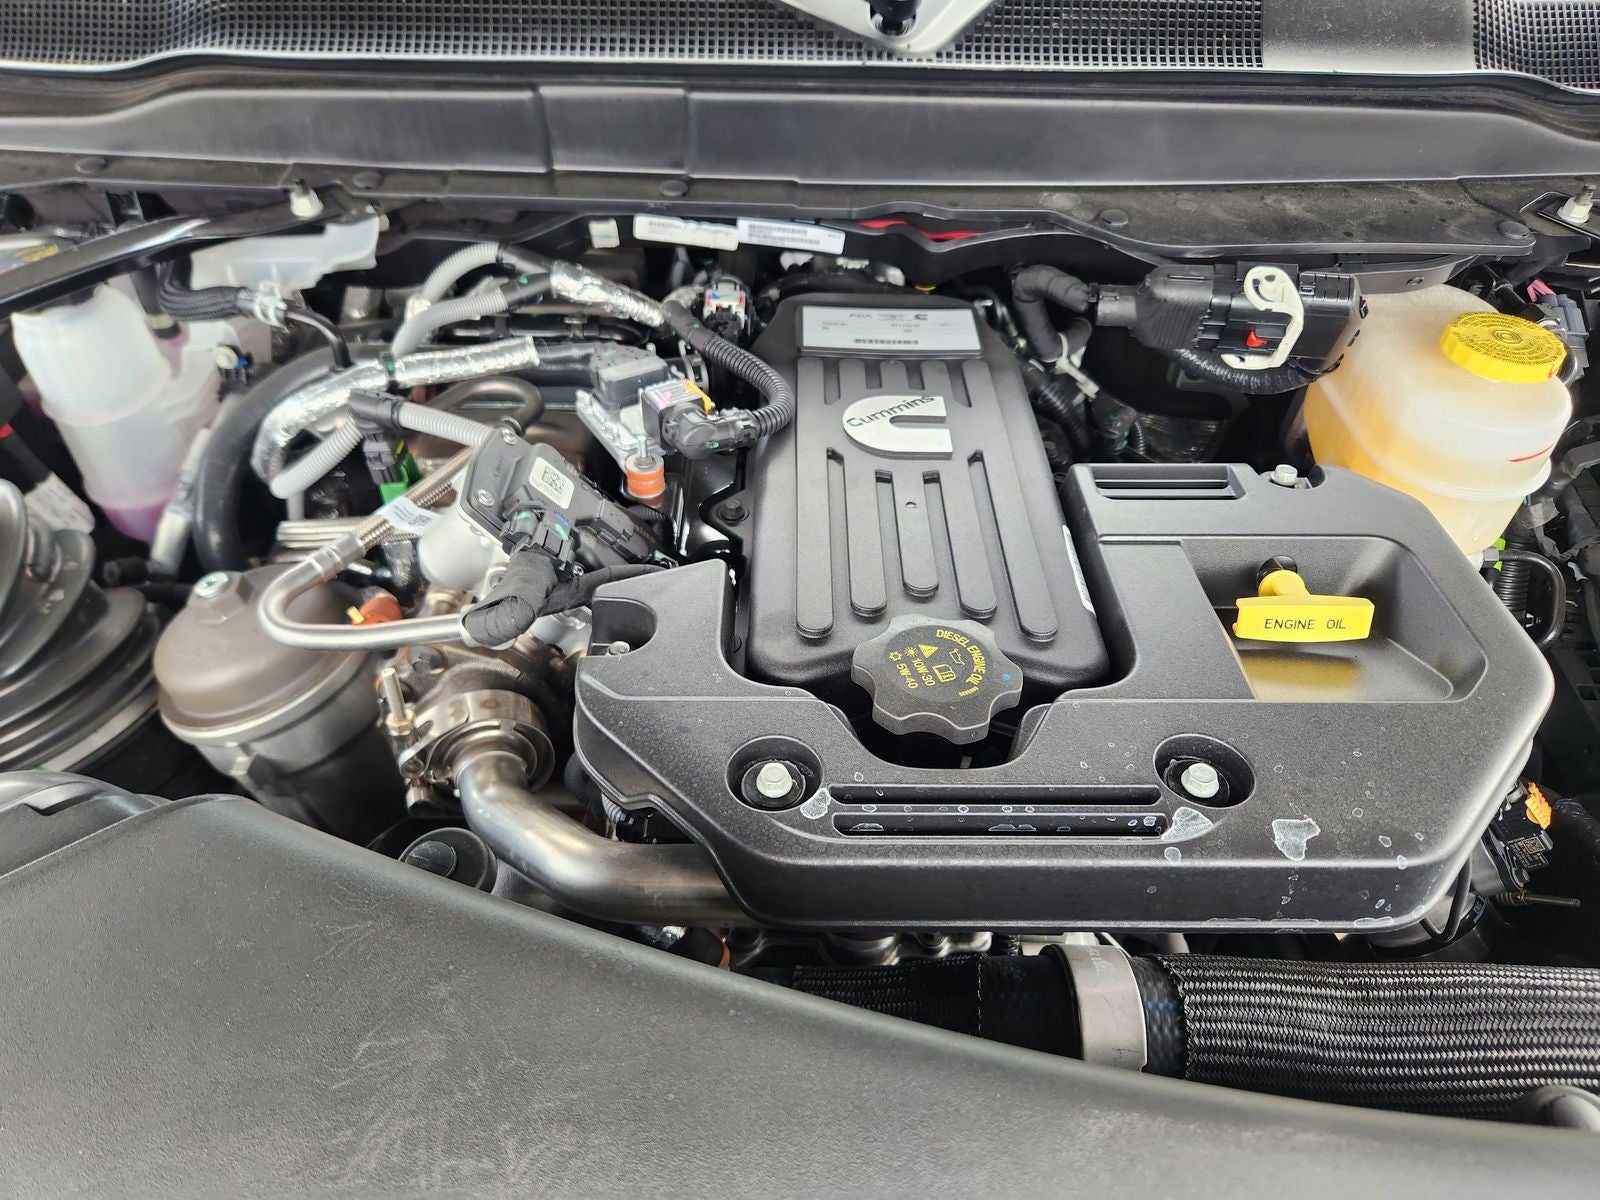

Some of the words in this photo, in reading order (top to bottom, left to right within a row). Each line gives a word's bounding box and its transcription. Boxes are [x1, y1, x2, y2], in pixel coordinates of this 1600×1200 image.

[846, 394, 934, 427] Cummins
[1264, 618, 1316, 629] ENGINE
[1326, 618, 1346, 629] OIL
[936, 629, 969, 647] DIESEL
[911, 658, 936, 686] 10W-30
[967, 645, 986, 674] ENGINE
[896, 663, 918, 689] 5W-40
[965, 672, 982, 685] OIL
